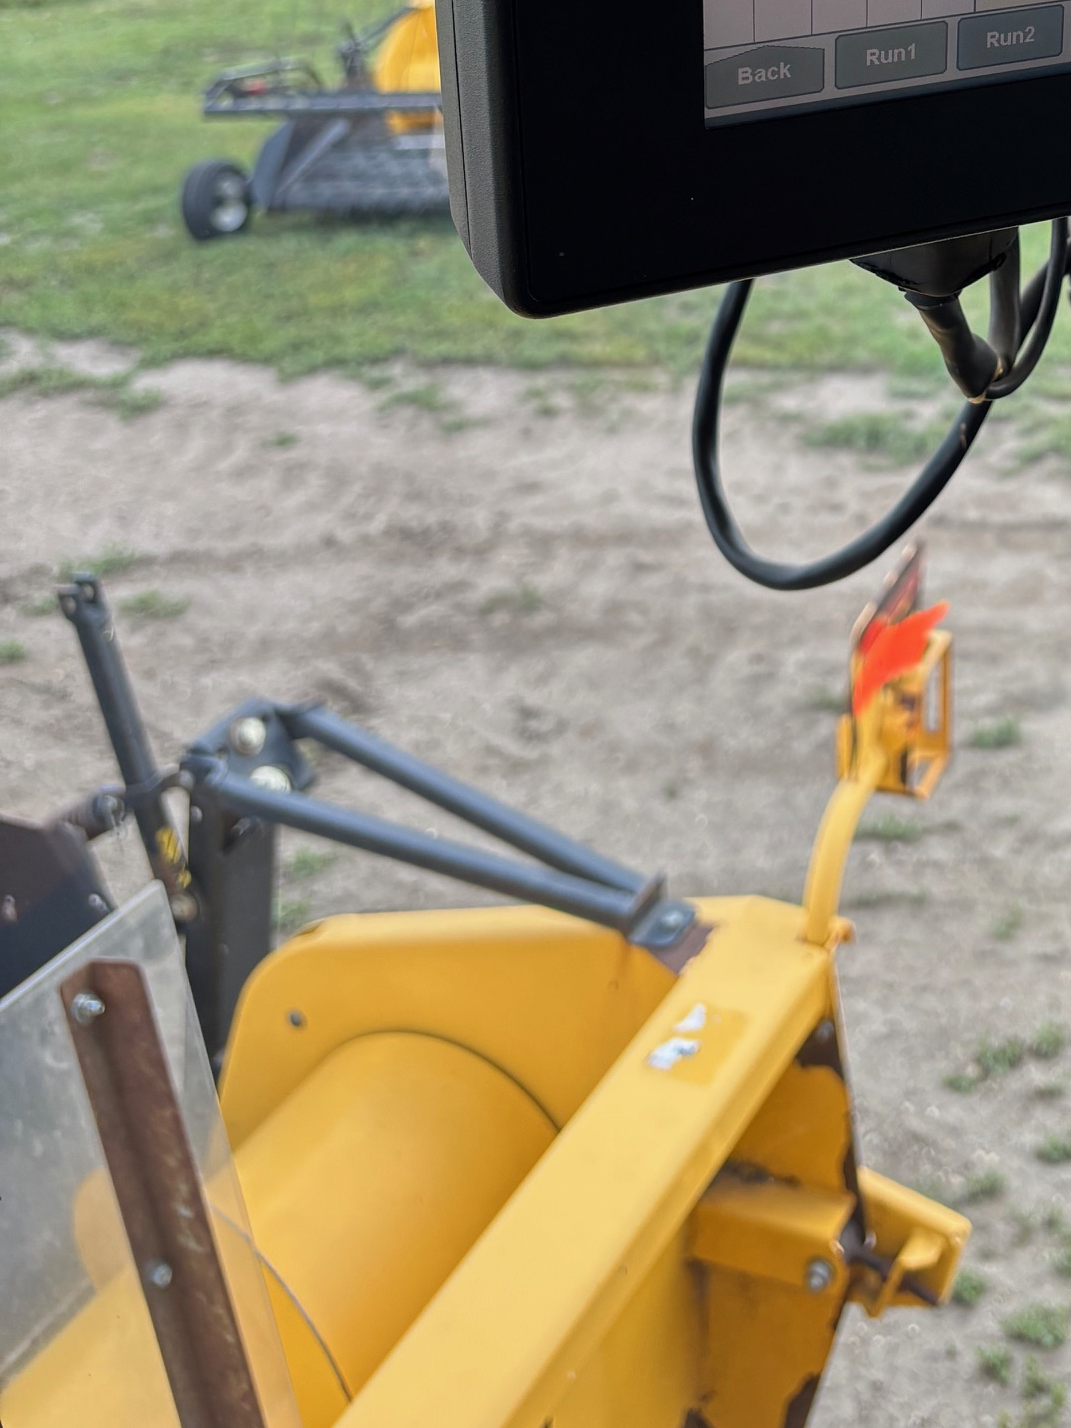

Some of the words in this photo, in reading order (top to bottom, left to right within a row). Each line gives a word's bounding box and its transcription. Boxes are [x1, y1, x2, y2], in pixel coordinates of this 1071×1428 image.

[986, 26, 1035, 48] Run2
[866, 43, 916, 65] Run1
[737, 61, 791, 85] Back
